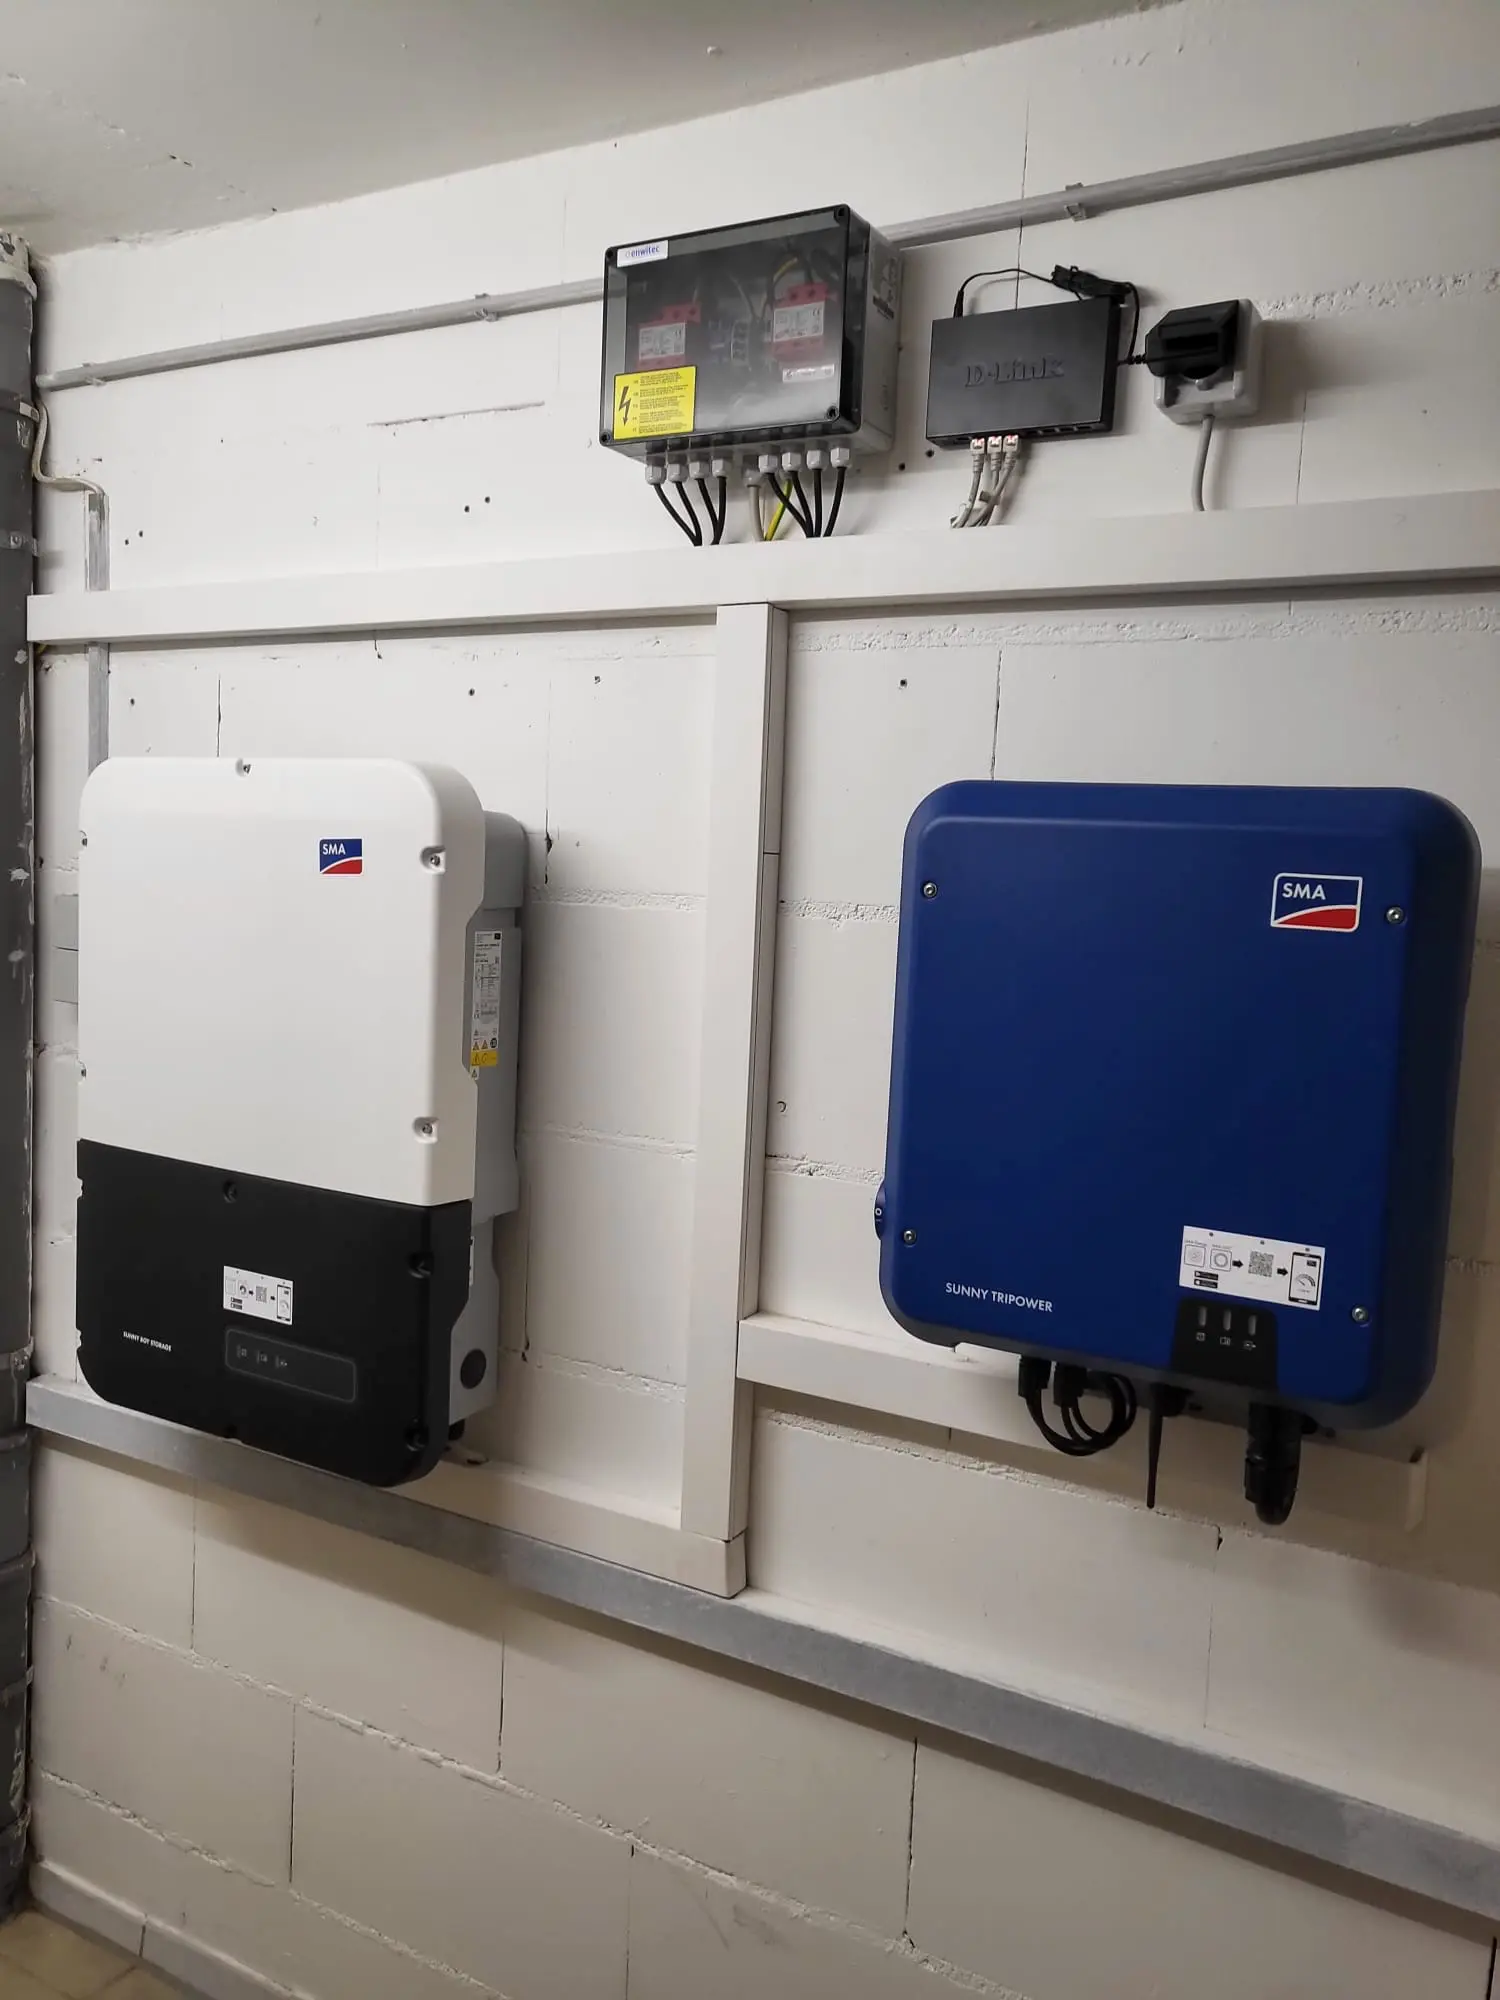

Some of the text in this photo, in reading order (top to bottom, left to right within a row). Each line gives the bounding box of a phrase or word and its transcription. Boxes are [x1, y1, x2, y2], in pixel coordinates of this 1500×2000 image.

[965, 357, 1064, 388] D-Link
[322, 843, 346, 855] SMA
[1282, 882, 1326, 900] SMA
[945, 1282, 1053, 1312] SUNNY TRIPOWER
[123, 1331, 172, 1352] SUNNY BOY STORAGE
